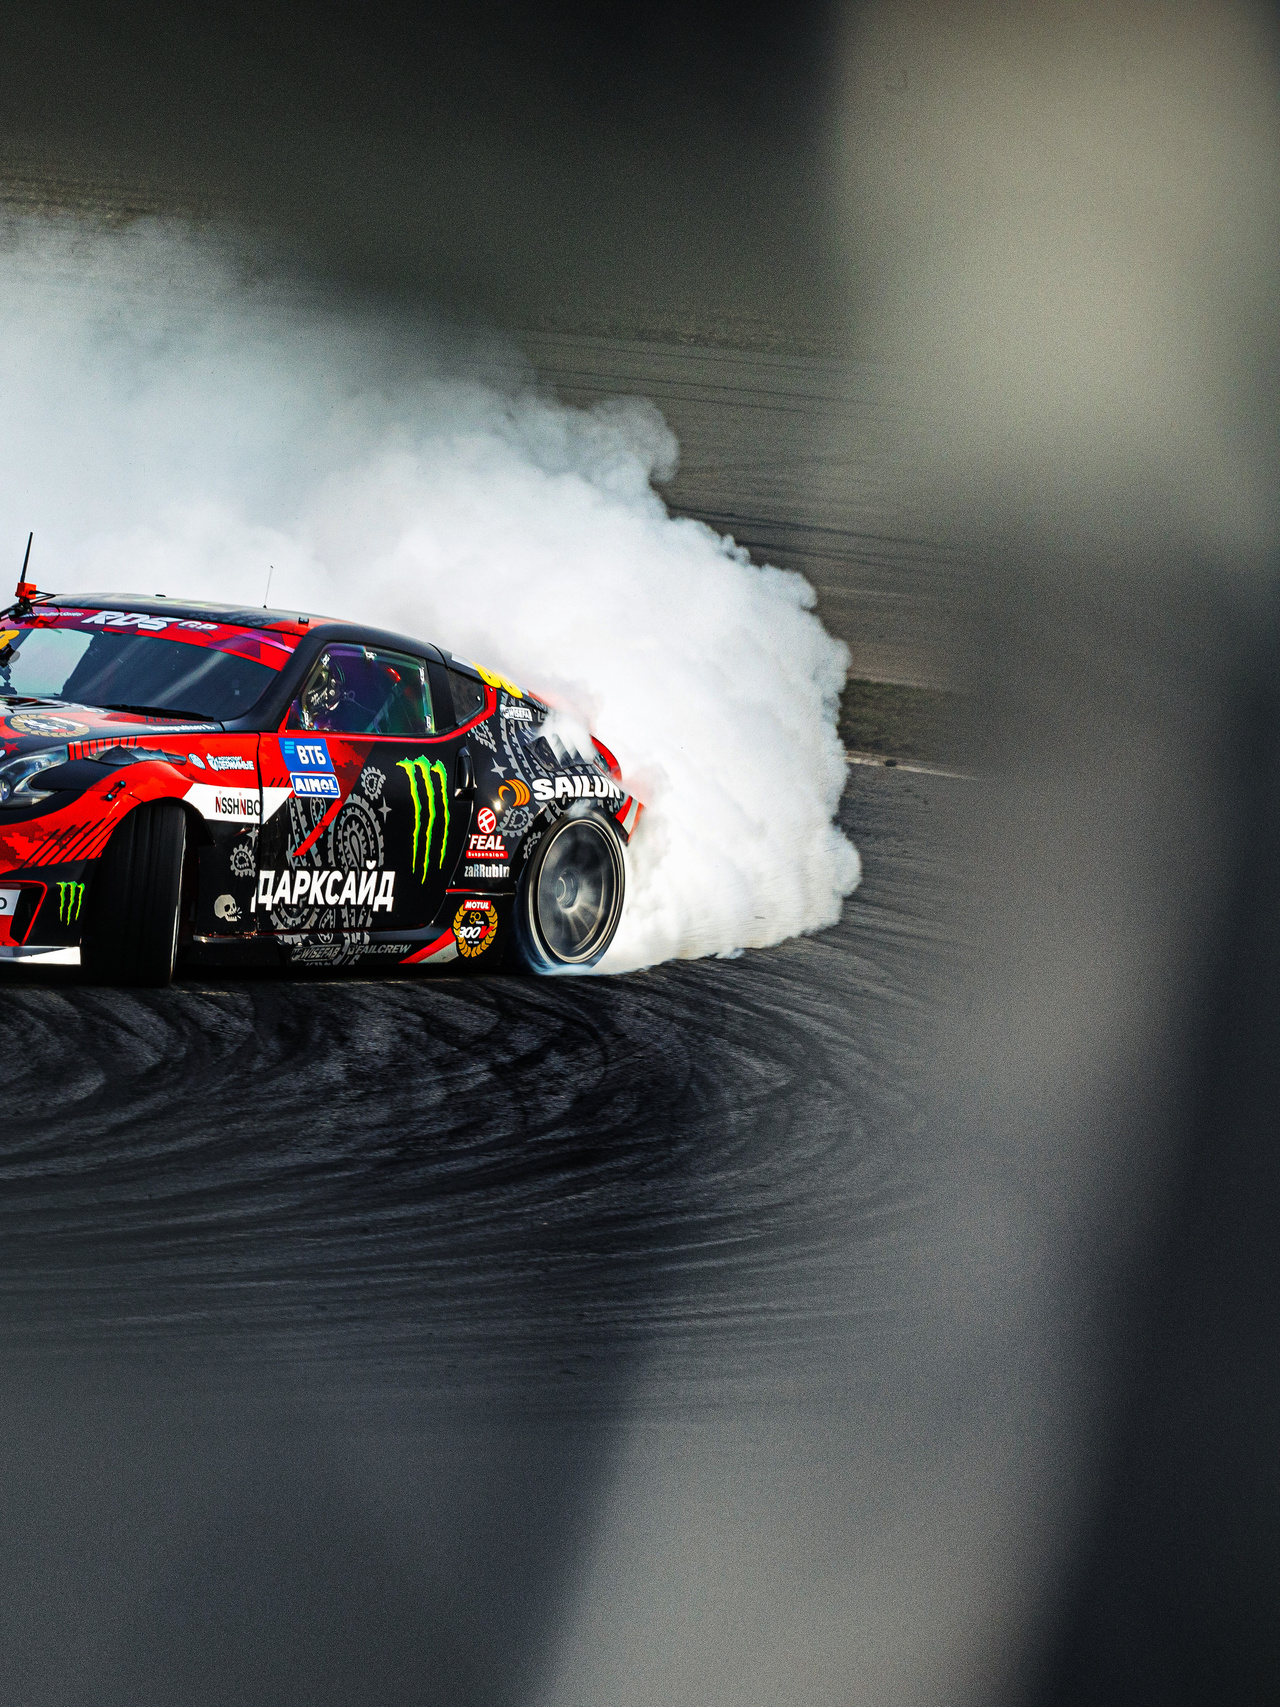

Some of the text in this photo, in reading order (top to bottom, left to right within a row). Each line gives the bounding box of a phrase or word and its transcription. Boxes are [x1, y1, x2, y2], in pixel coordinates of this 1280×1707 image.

[81, 610, 184, 631] RDS
[296, 745, 327, 765] ВТБ
[295, 777, 338, 794] AIMOL
[531, 775, 622, 801] SAILUN
[469, 834, 506, 851] FEAL
[250, 859, 396, 913] ДАРКСАЙД
[464, 901, 490, 910] MOTUL
[458, 926, 495, 939] 300V
[300, 944, 412, 960] WISEFAB FAILCREW
